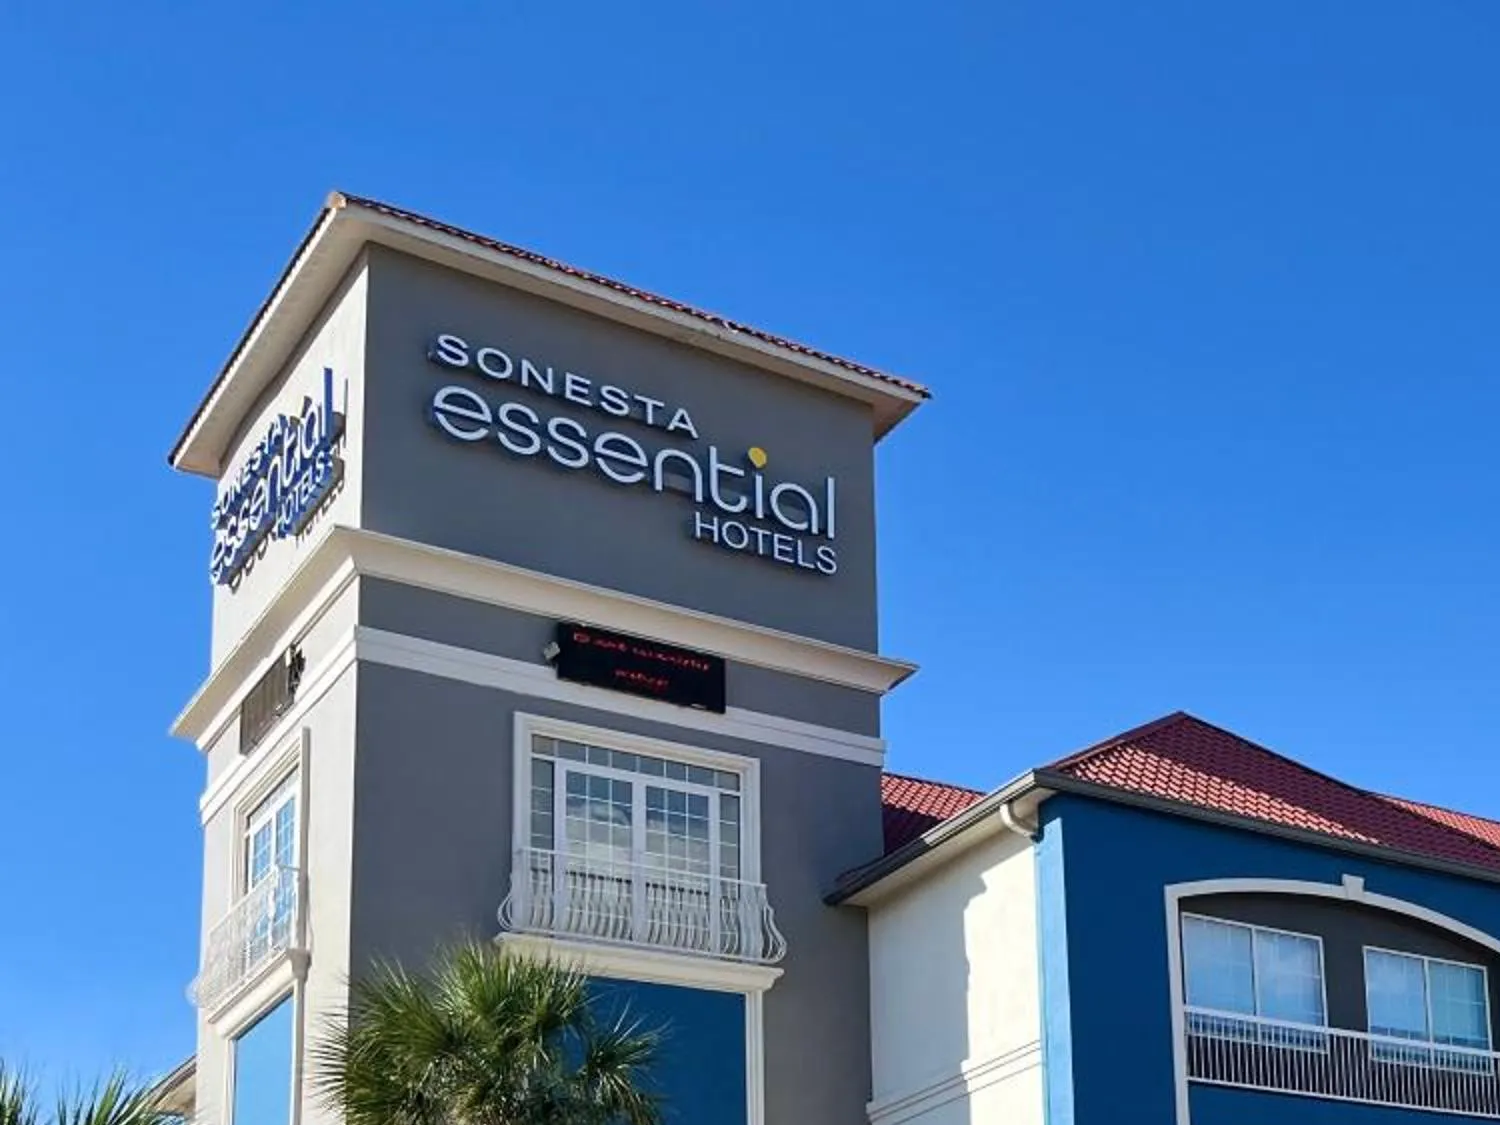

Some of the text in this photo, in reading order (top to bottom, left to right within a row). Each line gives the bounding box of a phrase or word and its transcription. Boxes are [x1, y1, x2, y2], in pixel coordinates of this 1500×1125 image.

[436, 334, 699, 440] SONESTA
[433, 385, 836, 540] essential
[695, 510, 838, 575] HOTELS
